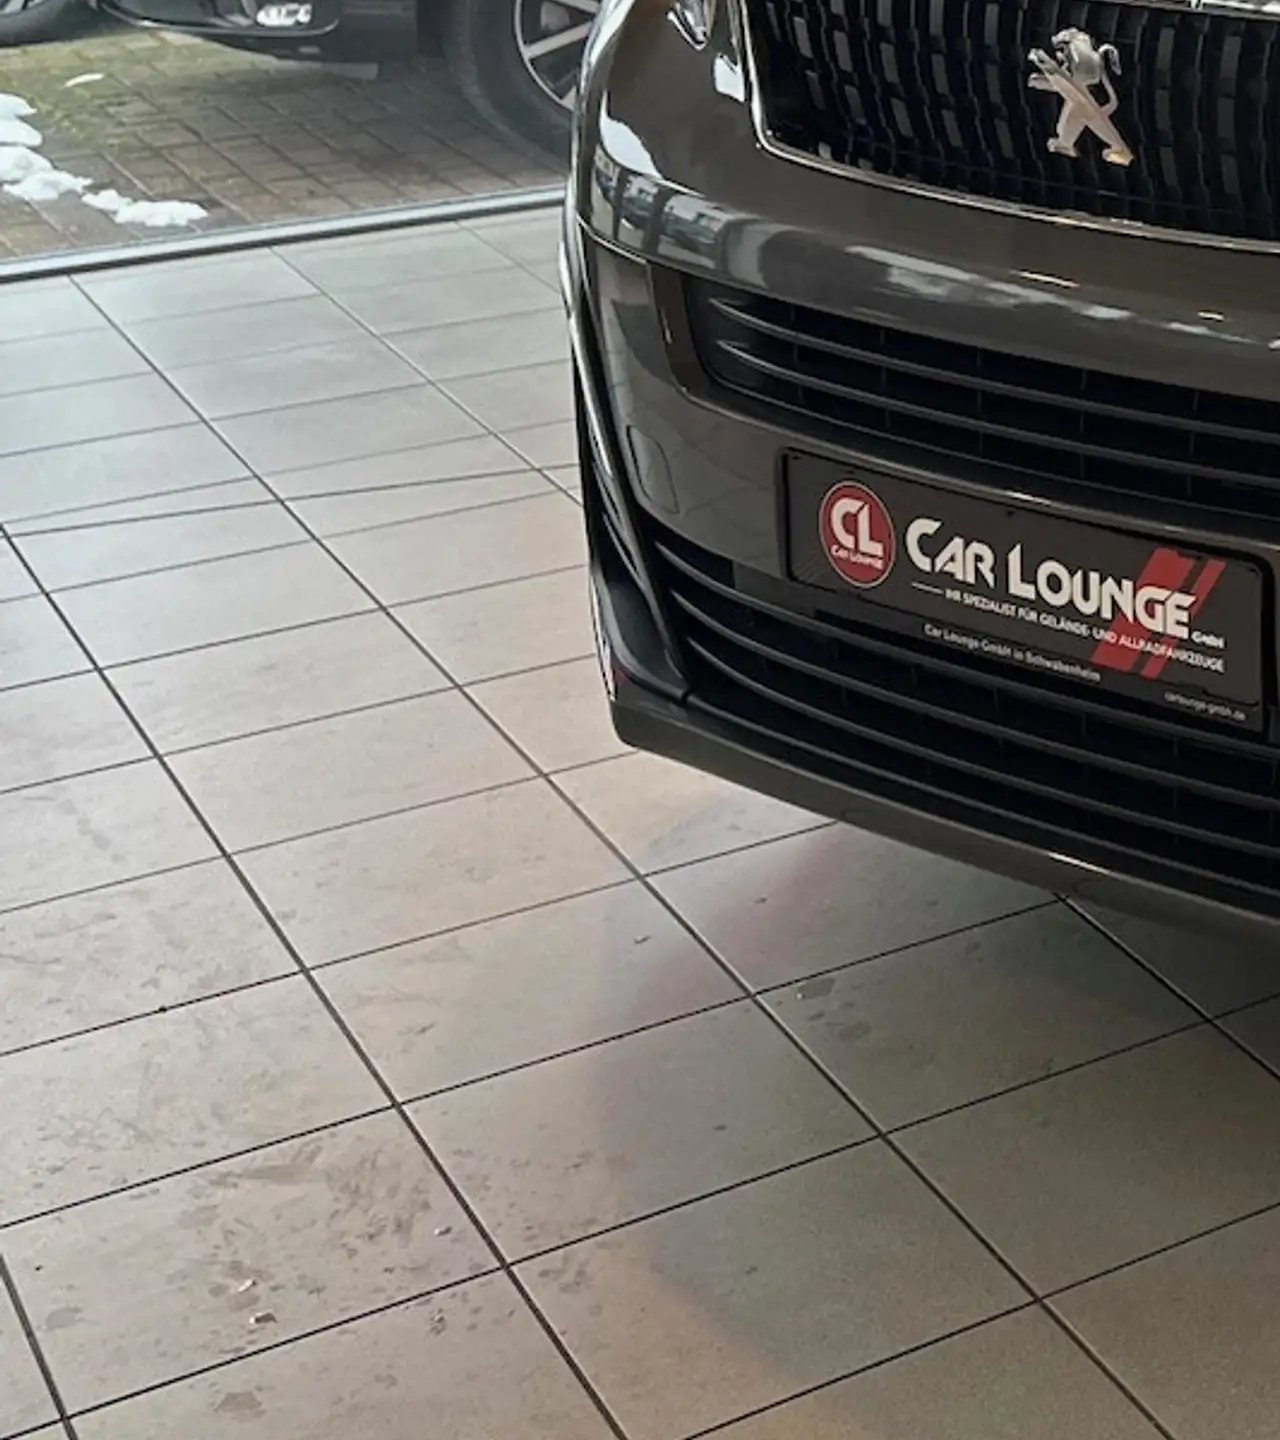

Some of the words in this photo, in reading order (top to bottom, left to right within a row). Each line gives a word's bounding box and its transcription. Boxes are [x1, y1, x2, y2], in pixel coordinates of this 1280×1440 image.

[830, 497, 885, 557] CL
[924, 623, 943, 639] Car
[943, 628, 980, 651] Lounge
[981, 639, 1012, 658] GmbH
[1013, 647, 1024, 660] in
[1024, 650, 1102, 682] Schwabenheim
[963, 593, 1016, 616] SPEZIALIST
[1018, 606, 1038, 624] FÜR
[1092, 627, 1118, 644] UND
[1118, 630, 1226, 673] ALLRADFAHRZEUGE
